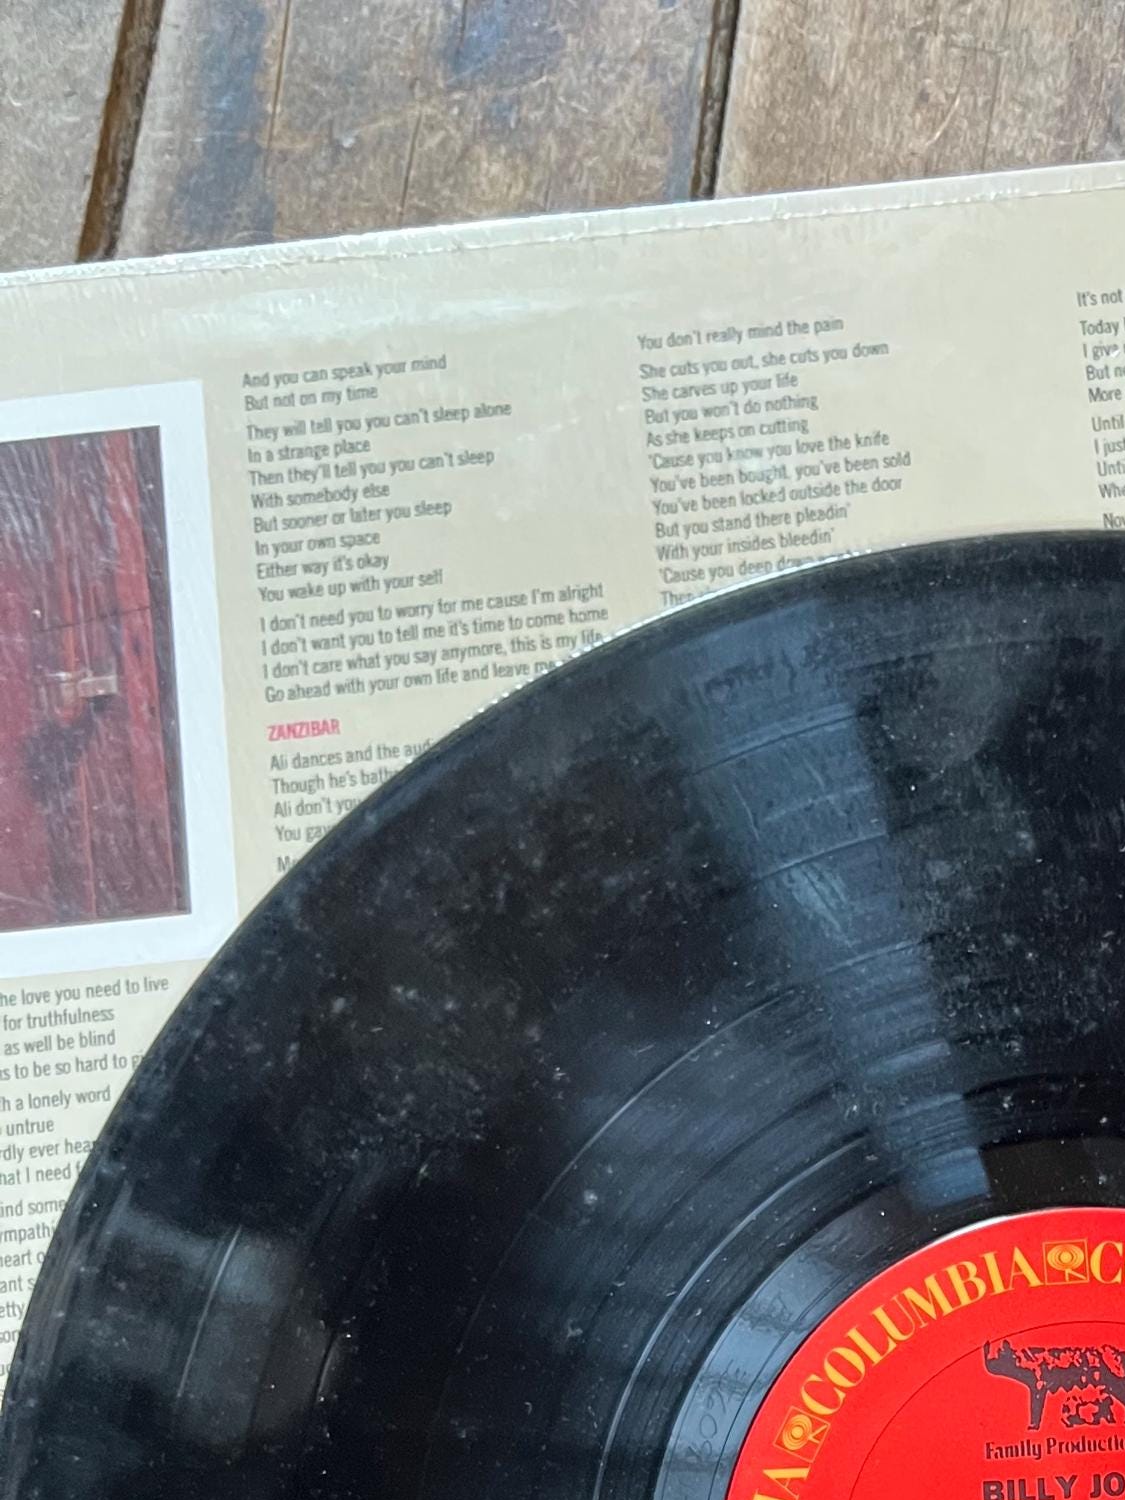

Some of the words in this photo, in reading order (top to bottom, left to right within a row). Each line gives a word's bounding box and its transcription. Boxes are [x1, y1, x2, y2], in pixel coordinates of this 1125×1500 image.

[1077, 291, 1097, 307] It's
[1101, 291, 1123, 305] not
[1080, 319, 1119, 336] Today
[242, 372, 270, 387] And
[274, 373, 299, 388] you
[303, 368, 328, 382] can
[332, 362, 373, 381] speak
[376, 362, 406, 378] your
[411, 355, 447, 371] mind
[1086, 365, 1110, 381] But
[244, 395, 269, 411] But
[273, 393, 295, 407] not
[300, 394, 317, 406] on
[321, 391, 342, 405] my
[347, 385, 378, 400] time
[642, 386, 668, 402] She
[672, 382, 717, 398] carves
[721, 382, 738, 396] up
[742, 376, 772, 394] your
[776, 372, 798, 388] life
[1092, 412, 1125, 432] Until
[248, 449, 261, 463] In
[266, 449, 274, 461] a
[278, 445, 329, 460] strange
[334, 439, 370, 456] place
[652, 499, 698, 516] You've
[702, 492, 736, 510] been
[740, 488, 786, 506] locked
[790, 480, 840, 500] outside
[845, 479, 868, 496] the
[872, 476, 902, 492] door
[267, 719, 340, 741] ZANZIBAR
[270, 755, 288, 771] Ali
[292, 750, 342, 769] dances
[346, 744, 373, 763] and
[377, 744, 400, 760] the
[3, 1016, 22, 1031] for
[27, 1008, 115, 1029] truthfulness
[4, 1042, 20, 1056] as
[24, 1035, 52, 1053] well
[57, 1035, 74, 1050] be
[79, 1029, 116, 1048] blind
[798, 1248, 1042, 1418] COLUMBIA
[985, 1438, 1042, 1460] Family
